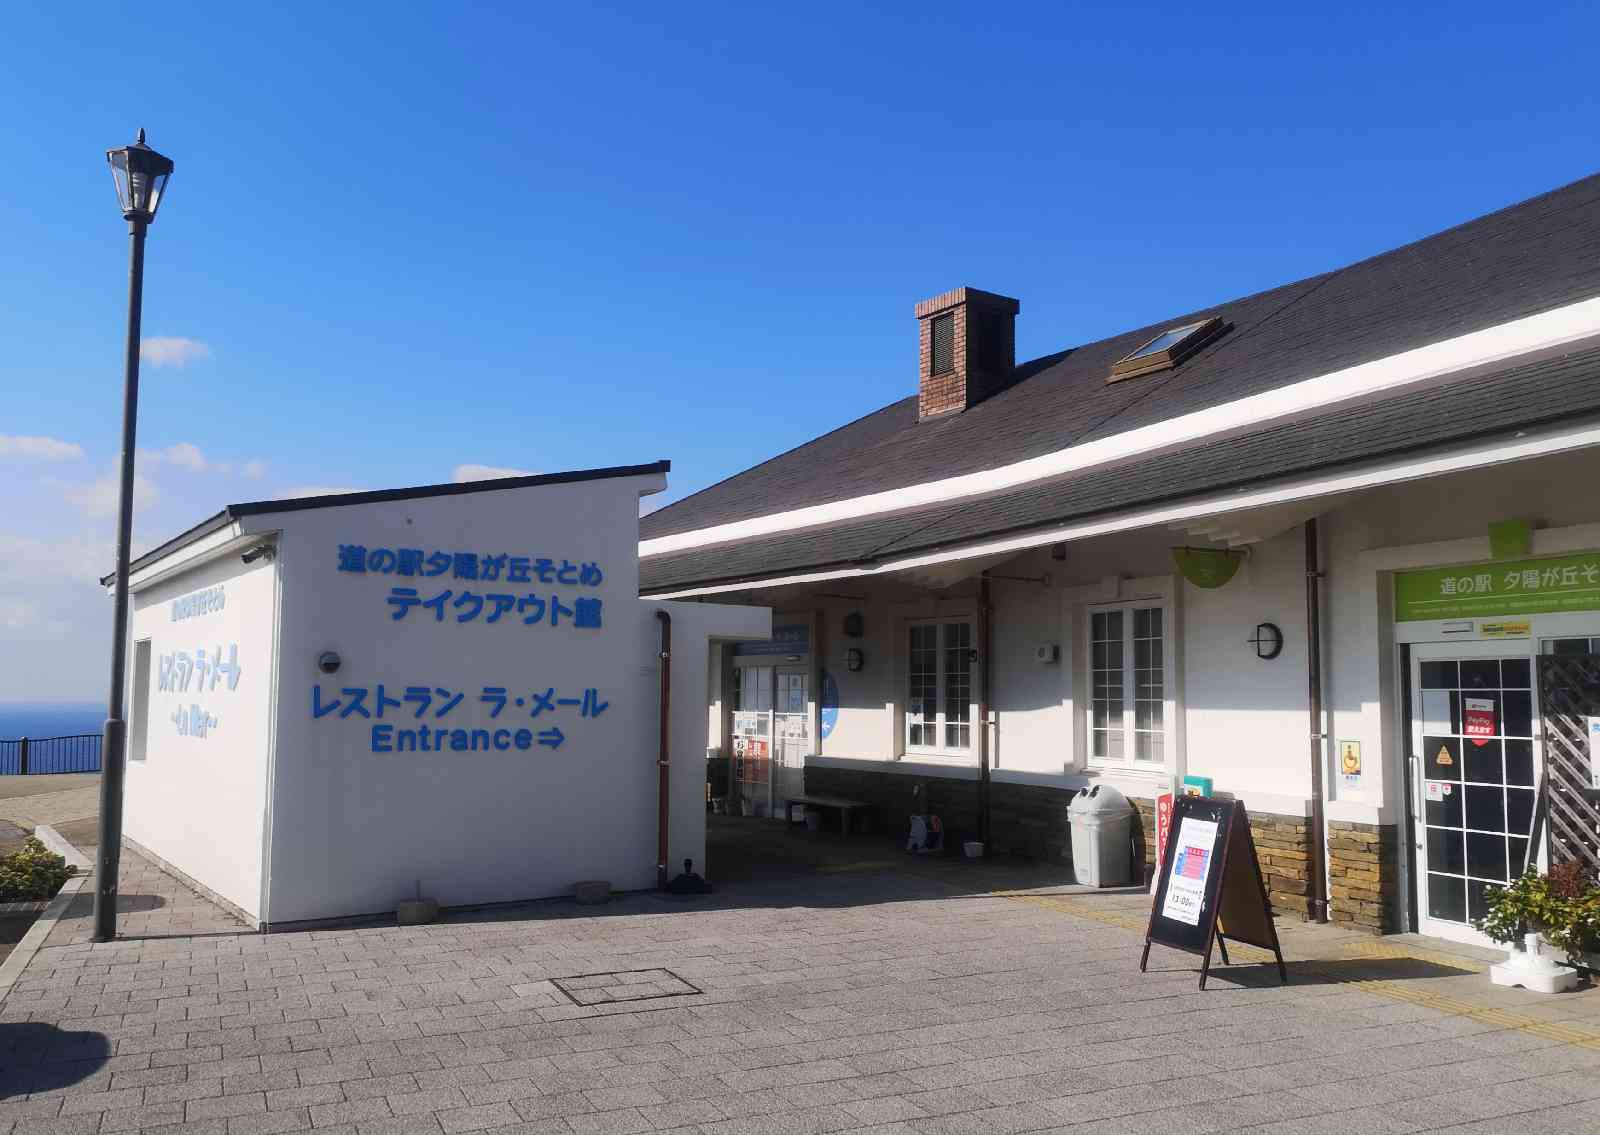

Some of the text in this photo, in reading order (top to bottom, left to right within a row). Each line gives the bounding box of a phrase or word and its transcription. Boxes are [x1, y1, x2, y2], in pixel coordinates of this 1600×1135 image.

[337, 545, 603, 586] 道の駅夕陽が丘そとめ
[1440, 574, 1493, 595] 道の駅
[387, 587, 603, 629] テイクアウト館
[312, 684, 609, 719] レストラン ラ・メール
[371, 724, 533, 753] Entrance
